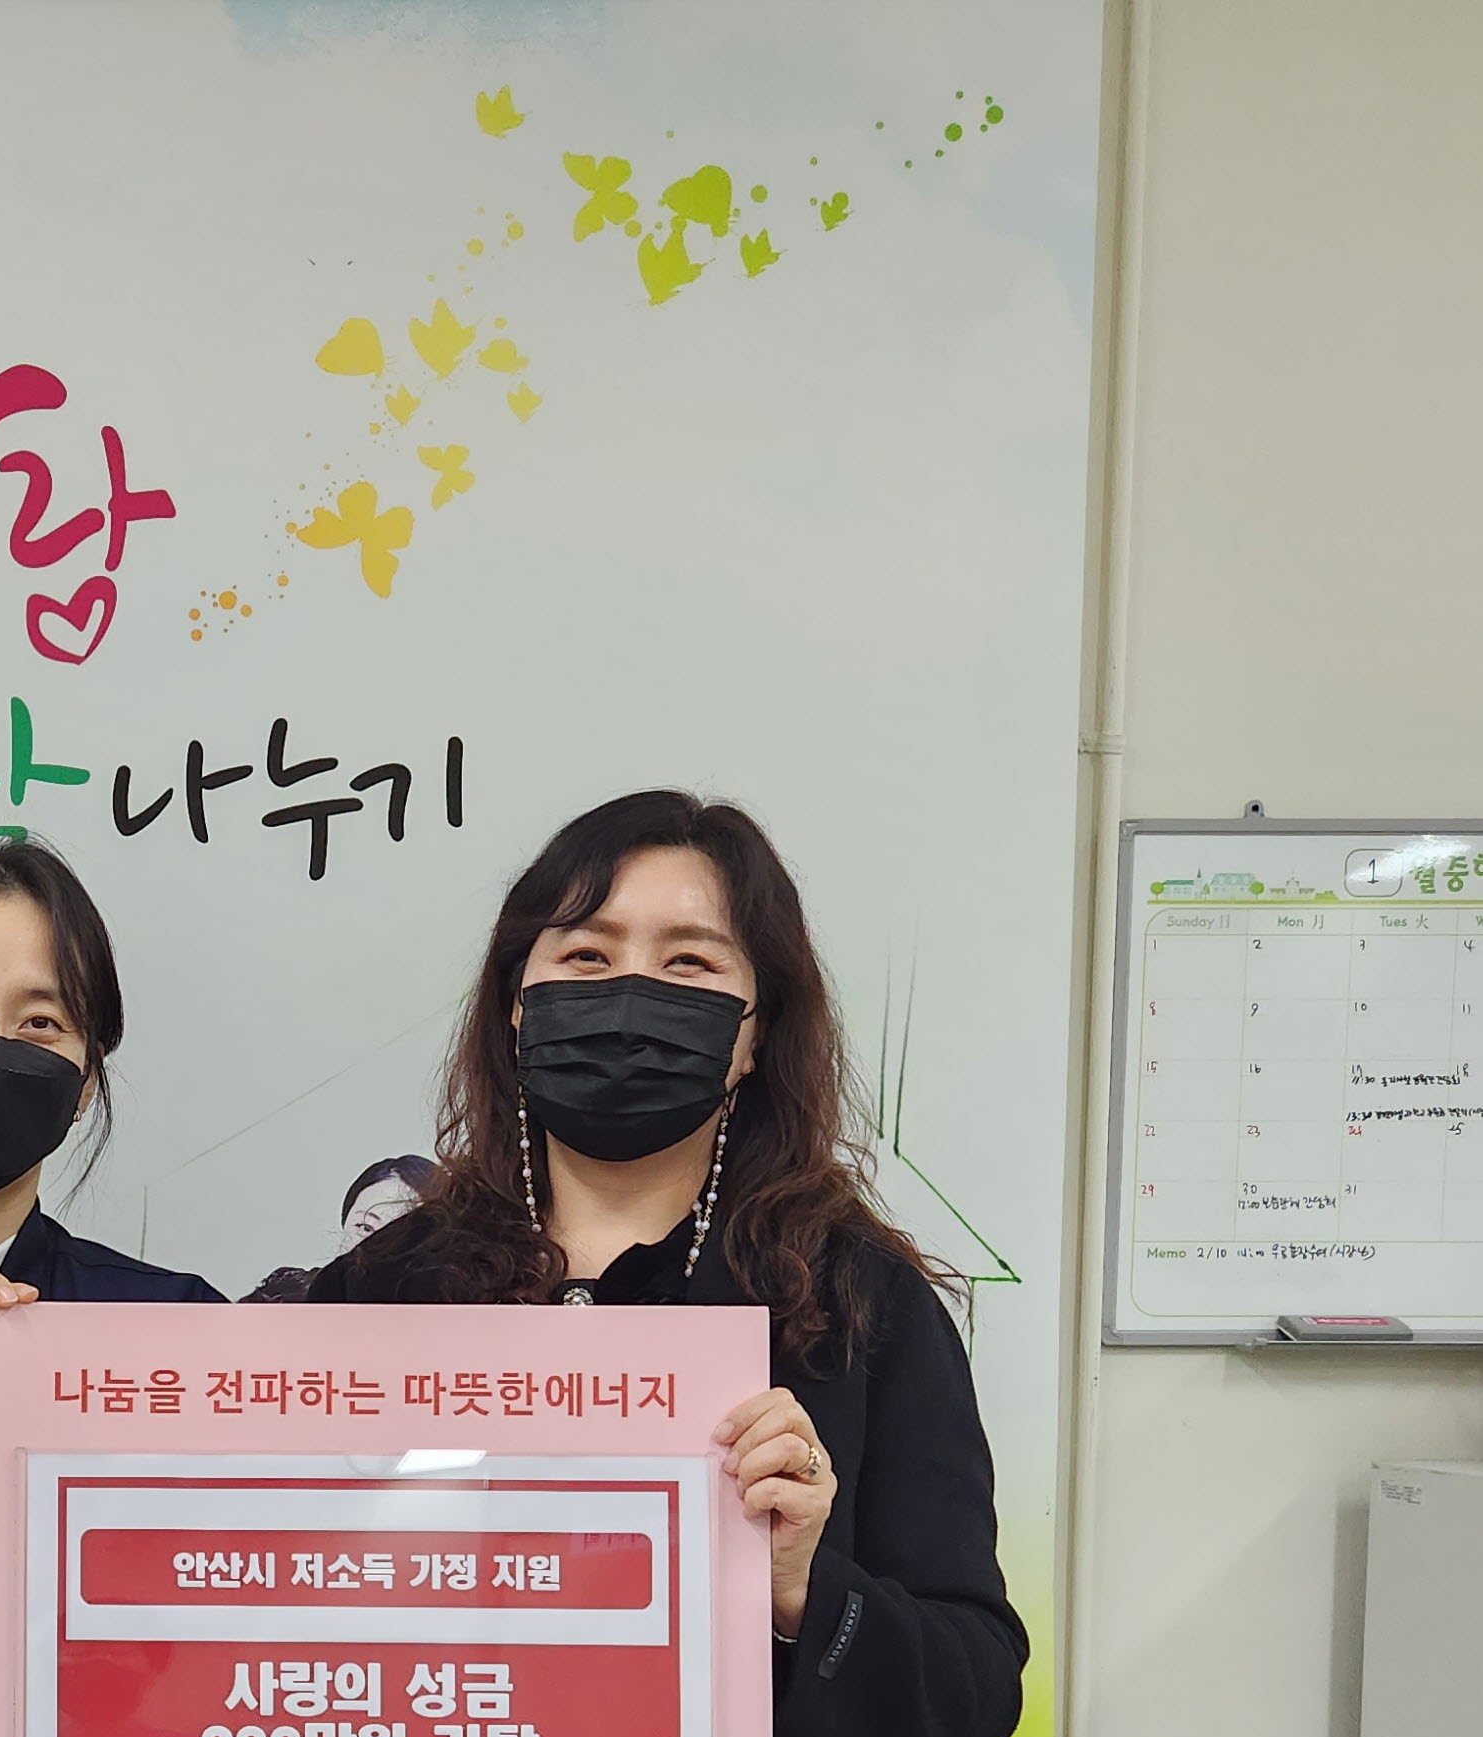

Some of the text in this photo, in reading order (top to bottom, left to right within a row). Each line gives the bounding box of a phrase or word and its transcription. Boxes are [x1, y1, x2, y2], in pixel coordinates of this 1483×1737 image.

[113, 717, 464, 881] 나누기
[1166, 915, 1214, 930] Sunday
[1277, 916, 1304, 928] Mon
[1380, 915, 1408, 928] Tues
[1252, 939, 1264, 950] 2
[1359, 939, 1366, 951] 3
[1463, 939, 1475, 952] 4
[1250, 1002, 1259, 1017] 9
[1354, 1001, 1368, 1012] 10
[1462, 1003, 1471, 1015] 11
[1146, 1060, 1159, 1074] 15
[1249, 1063, 1262, 1074] 16
[1144, 1124, 1157, 1137] 22
[1247, 1124, 1261, 1138] 23
[1140, 1184, 1155, 1197] 29
[1242, 1182, 1258, 1196] 30
[1344, 1184, 1357, 1195] 31
[1146, 1248, 1187, 1259] Memo
[1196, 1247, 1227, 1260] 2/10
[53, 1368, 678, 1419] 나눔을 전파하는 따뜻한에너지
[172, 1551, 562, 1592] 안산시 저소득 가정 지원
[223, 1660, 514, 1719] 사랑의 성금
